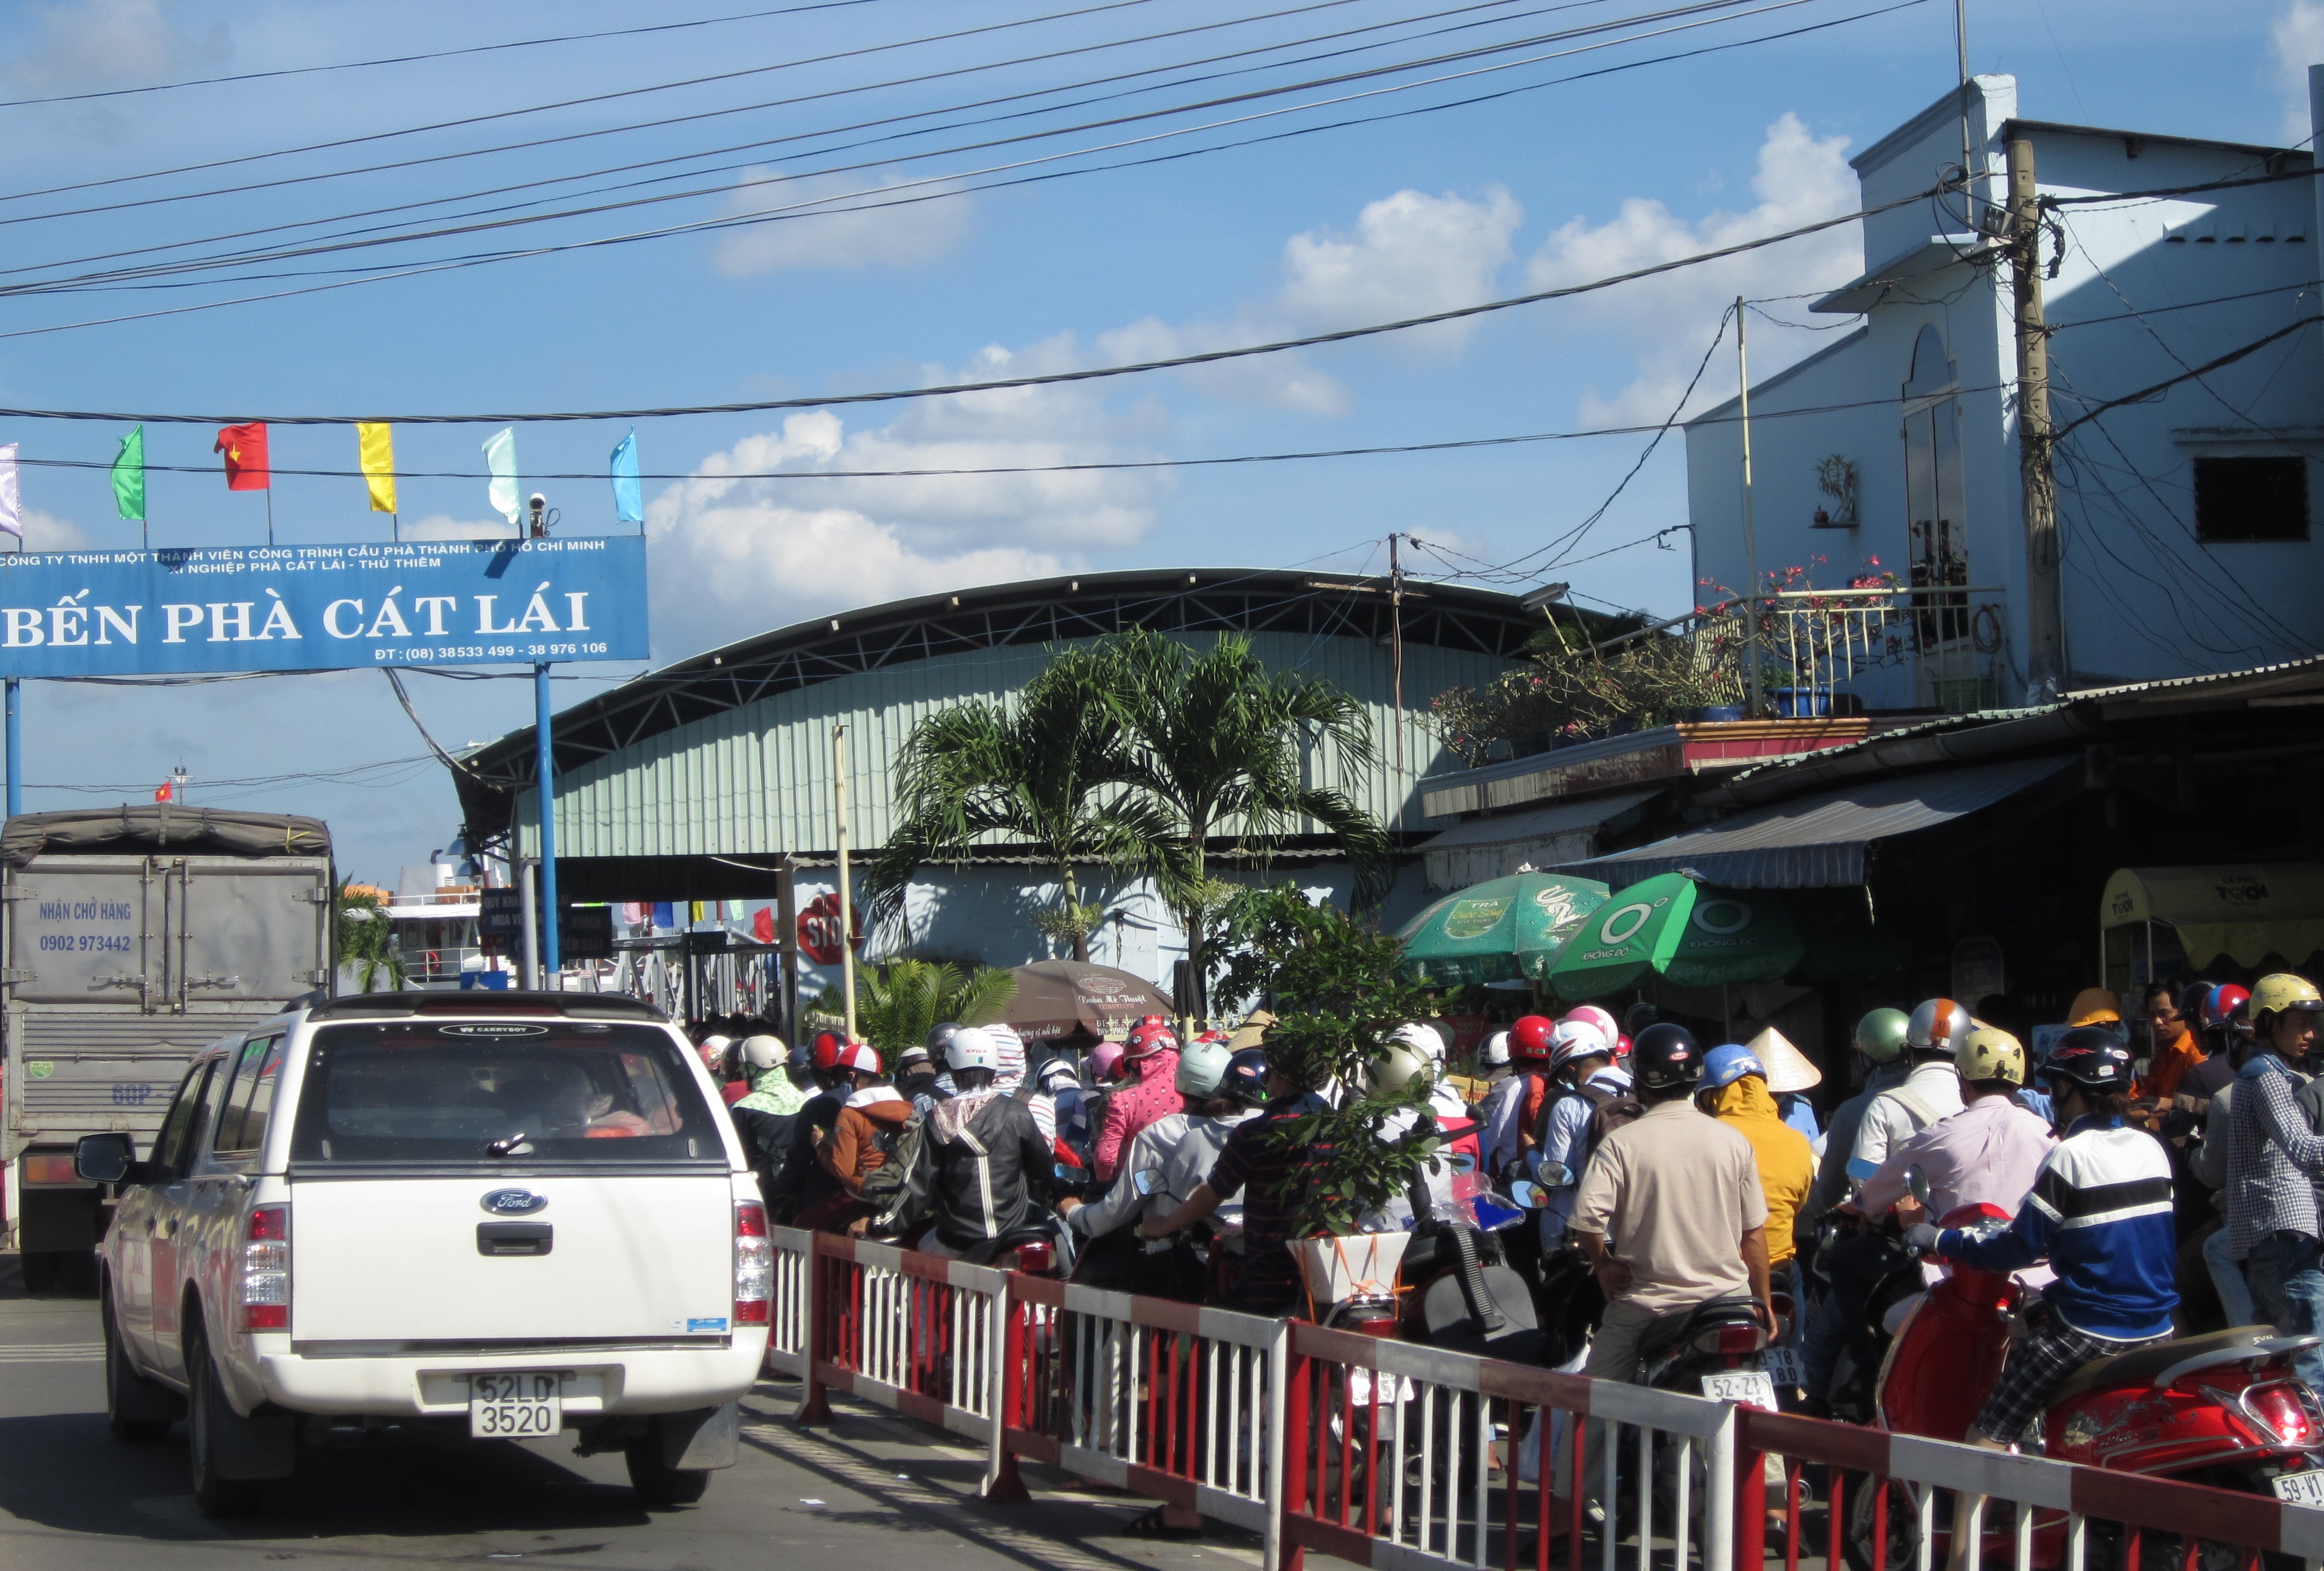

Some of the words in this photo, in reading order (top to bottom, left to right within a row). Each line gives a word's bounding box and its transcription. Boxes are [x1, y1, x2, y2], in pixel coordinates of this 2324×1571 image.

[0, 554, 41, 567] CÔNG
[45, 555, 64, 565] TY
[68, 553, 110, 564] TNHH
[114, 551, 147, 565] MỘT
[151, 551, 203, 562] THÀNH
[208, 549, 243, 560] VIÊN
[248, 548, 292, 559] CÔNG
[297, 547, 343, 558] TRÌNH
[347, 544, 379, 557] CẦU
[384, 544, 415, 556] PHÀ
[418, 542, 470, 554] THÀNH
[511, 539, 533, 552] HỒ
[537, 540, 564, 551] CHÍ
[567, 540, 605, 551] MINH
[187, 561, 246, 574] NGHIỆP
[250, 560, 282, 572] PHÀ
[285, 558, 316, 571] CÁT
[321, 558, 346, 570] LÁI
[358, 557, 389, 570] THỦ
[393, 557, 441, 568] THIÊM
[1, 588, 142, 647] BẾN
[161, 588, 303, 643] PHÀ
[322, 585, 456, 639] CÁT
[473, 581, 591, 634] LÁI
[405, 647, 434, 661] (08)
[438, 647, 483, 658] 38533
[487, 645, 514, 657] 499
[527, 645, 545, 656] 38
[550, 644, 577, 655] 976
[581, 642, 607, 654] 106
[40, 898, 71, 923] NHẬN
[74, 896, 98, 920] CHỞ
[101, 898, 131, 920] HÀNG
[1470, 900, 1498, 909] TRÀ
[491, 914, 510, 926] MUA
[807, 916, 842, 947] STO
[40, 935, 74, 950] 0902
[79, 935, 130, 951] 973442
[1690, 937, 1736, 949] KHÔNG
[1580, 949, 1615, 962] KHÔNG
[497, 1193, 533, 1208] Ford
[478, 1375, 551, 1403] 52LD
[481, 1405, 551, 1433] 3520
